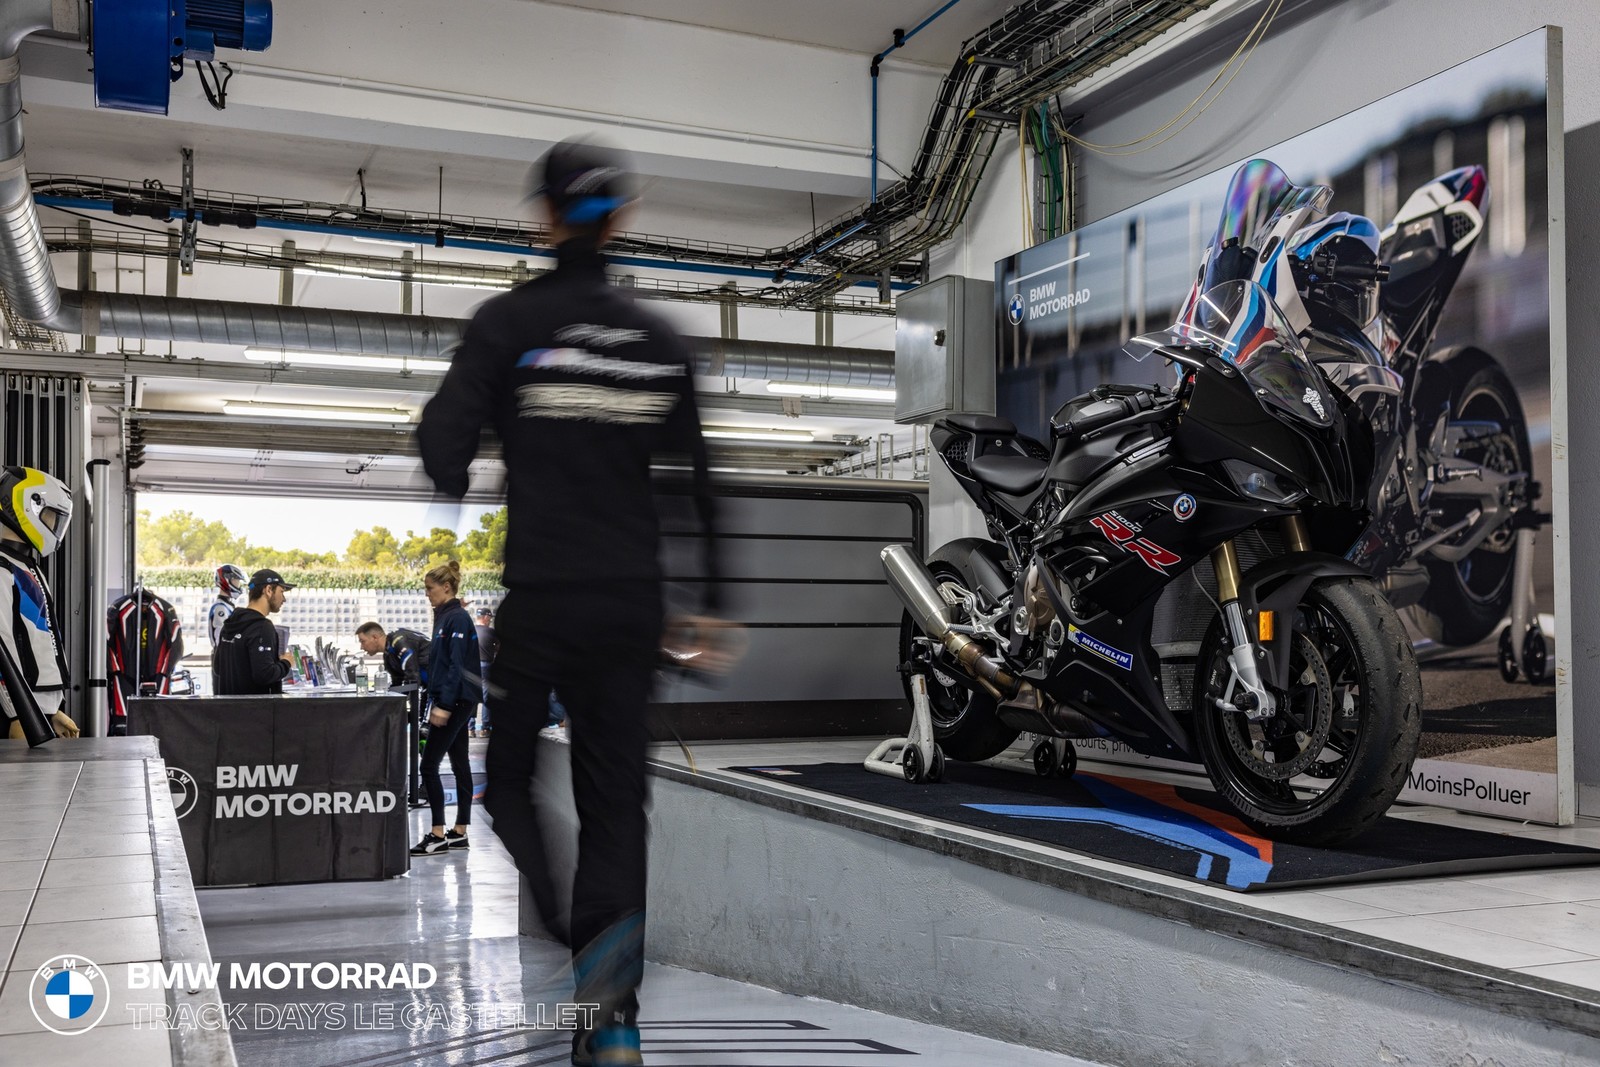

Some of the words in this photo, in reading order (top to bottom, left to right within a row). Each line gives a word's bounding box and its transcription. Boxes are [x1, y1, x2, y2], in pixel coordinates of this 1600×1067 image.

[1029, 288, 1091, 320] MOTORRAD
[1030, 281, 1057, 302] BMW
[1109, 509, 1142, 533] S1000
[1089, 512, 1182, 577] RR
[1081, 636, 1129, 664] MICHELIN
[1076, 737, 1109, 753] courts,
[216, 764, 299, 789] BMW
[1408, 771, 1531, 805] MoinsPolluer
[215, 790, 397, 819] MOTORRAD
